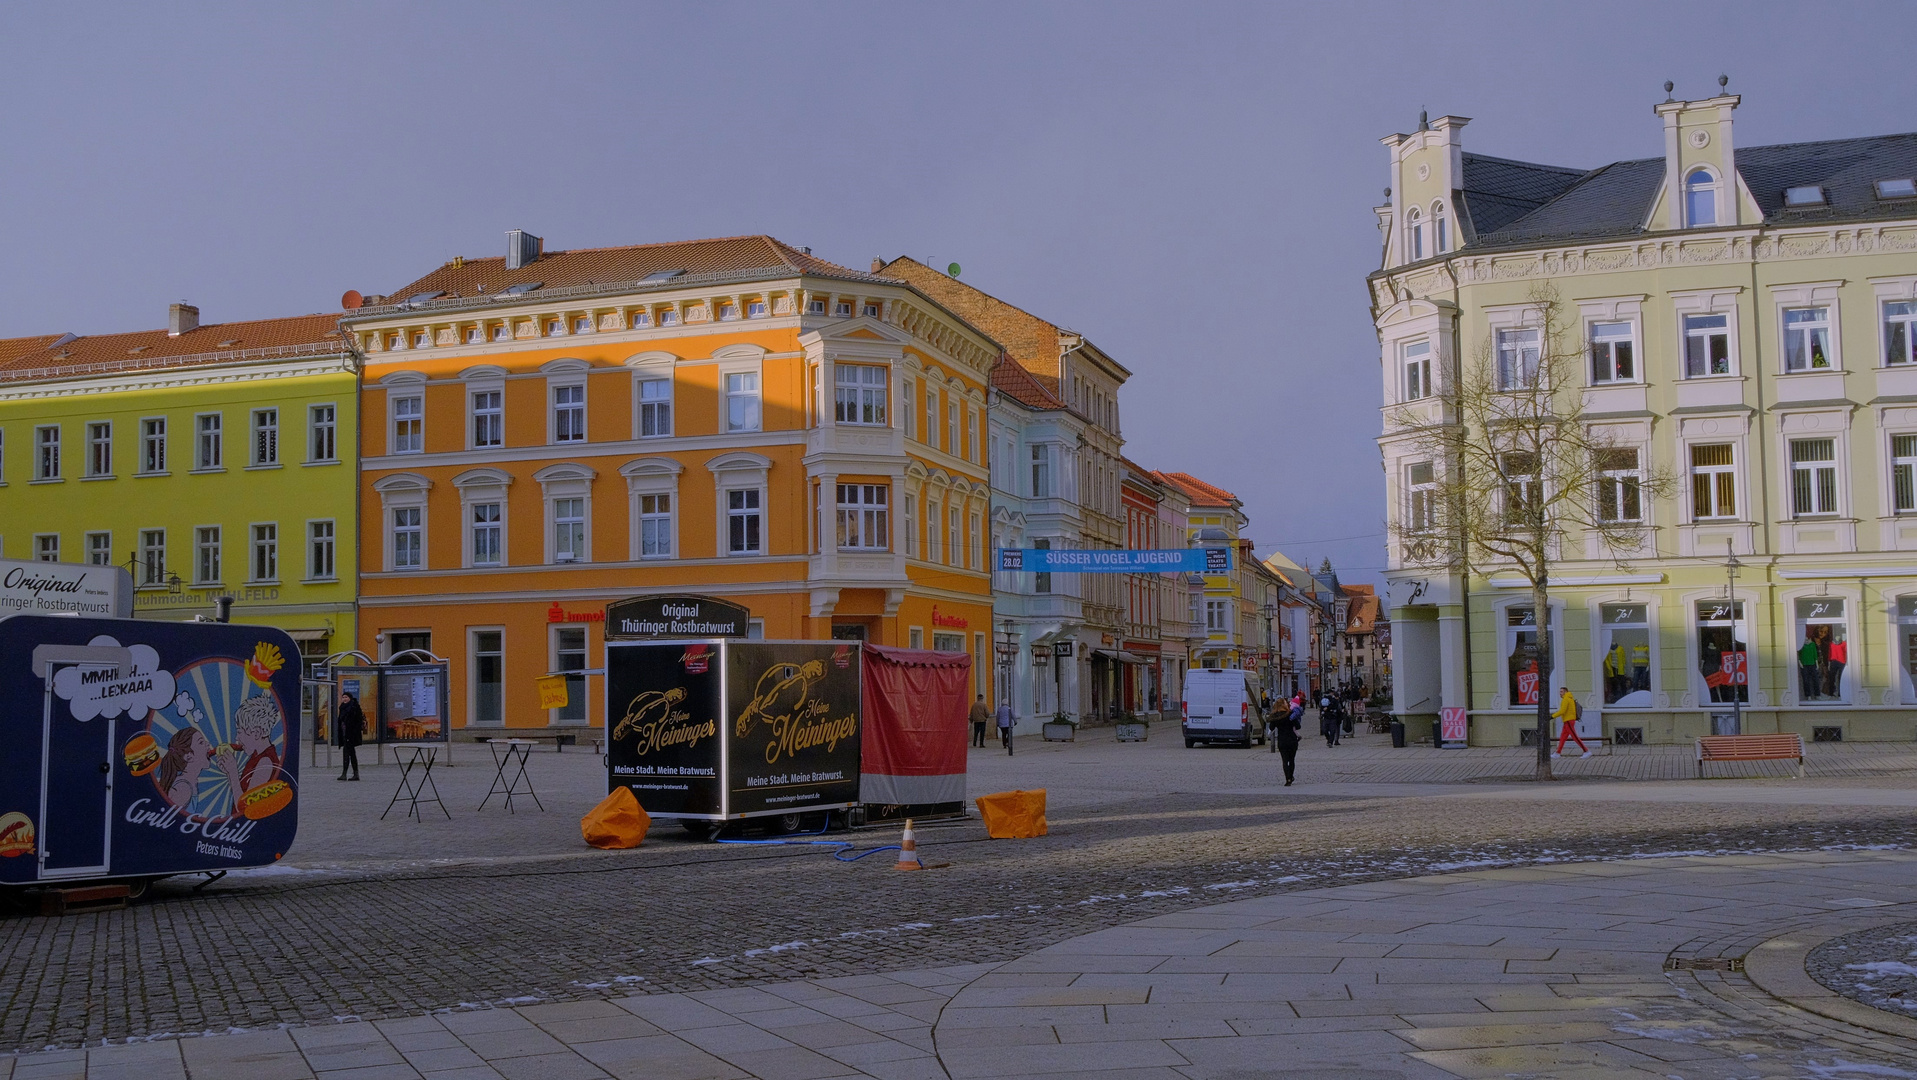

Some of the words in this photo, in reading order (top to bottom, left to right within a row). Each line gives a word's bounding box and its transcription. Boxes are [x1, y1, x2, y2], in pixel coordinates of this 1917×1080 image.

[1003, 557, 1023, 568] 28.02.
[1046, 550, 1091, 564] SÜSSER
[1093, 552, 1132, 564] VOGEL
[1134, 552, 1182, 564] JUGEND
[3, 567, 87, 597] Original
[1, 594, 34, 611] ringer
[37, 597, 110, 614] Rostbratwurst
[134, 592, 201, 606] huhmoden
[567, 609, 606, 622] Immob
[661, 603, 699, 620] Original
[621, 618, 668, 636] Thüringer
[671, 620, 735, 634] Rostbratwurst
[1521, 673, 1537, 682] SALE
[804, 698, 830, 719] Meine
[668, 709, 691, 725] Meine
[1444, 719, 1463, 727] SALE
[637, 719, 716, 756] Meininger
[765, 710, 857, 764] Meininger
[614, 765, 635, 774] Meine
[636, 765, 656, 775] Stadt.
[657, 765, 678, 775] Meine
[679, 766, 716, 776] Bratwurst.
[747, 775, 768, 787] Meine
[770, 773, 789, 785] Stadt.
[790, 772, 811, 783] Meine
[812, 770, 844, 781] Bratwurst.
[631, 783, 689, 791] www.meininger-bratwurst.de
[765, 792, 820, 804] www.meininger-bratwurst.de
[125, 797, 183, 830] Grill
[179, 813, 203, 834] &
[201, 814, 258, 844] Chill
[195, 840, 220, 856] Peters
[220, 844, 243, 860] Imbiss
